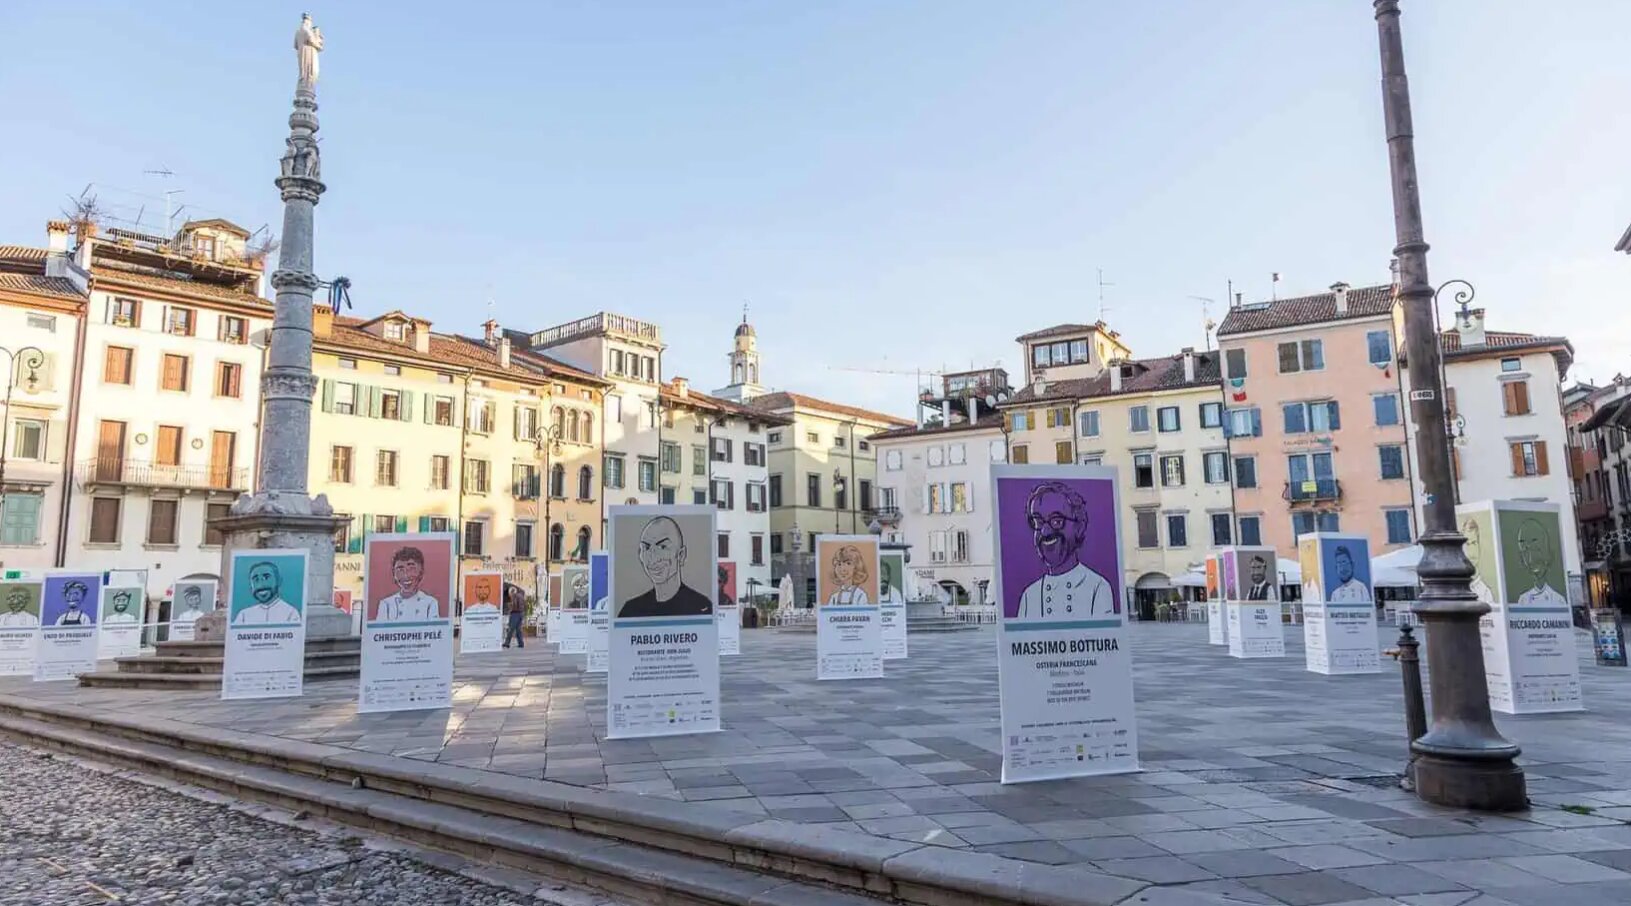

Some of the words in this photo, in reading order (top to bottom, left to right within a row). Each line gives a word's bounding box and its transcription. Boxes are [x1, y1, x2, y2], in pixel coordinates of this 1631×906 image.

[1509, 619, 1541, 630] RICCARDO
[1541, 619, 1571, 629] CAMANINI
[237, 633, 263, 641] DAVIDE
[272, 632, 294, 640] FABIO
[373, 633, 422, 642] CHRISTOPHE
[423, 630, 443, 640] PELÉ
[630, 634, 661, 645] PABLO
[663, 633, 698, 644] RIVERO
[1011, 640, 1067, 656] MASSIMO
[1070, 638, 1119, 653] BOTTURA
[1036, 661, 1059, 669] OSTERIA
[1059, 659, 1098, 668] FRANCESCANA
